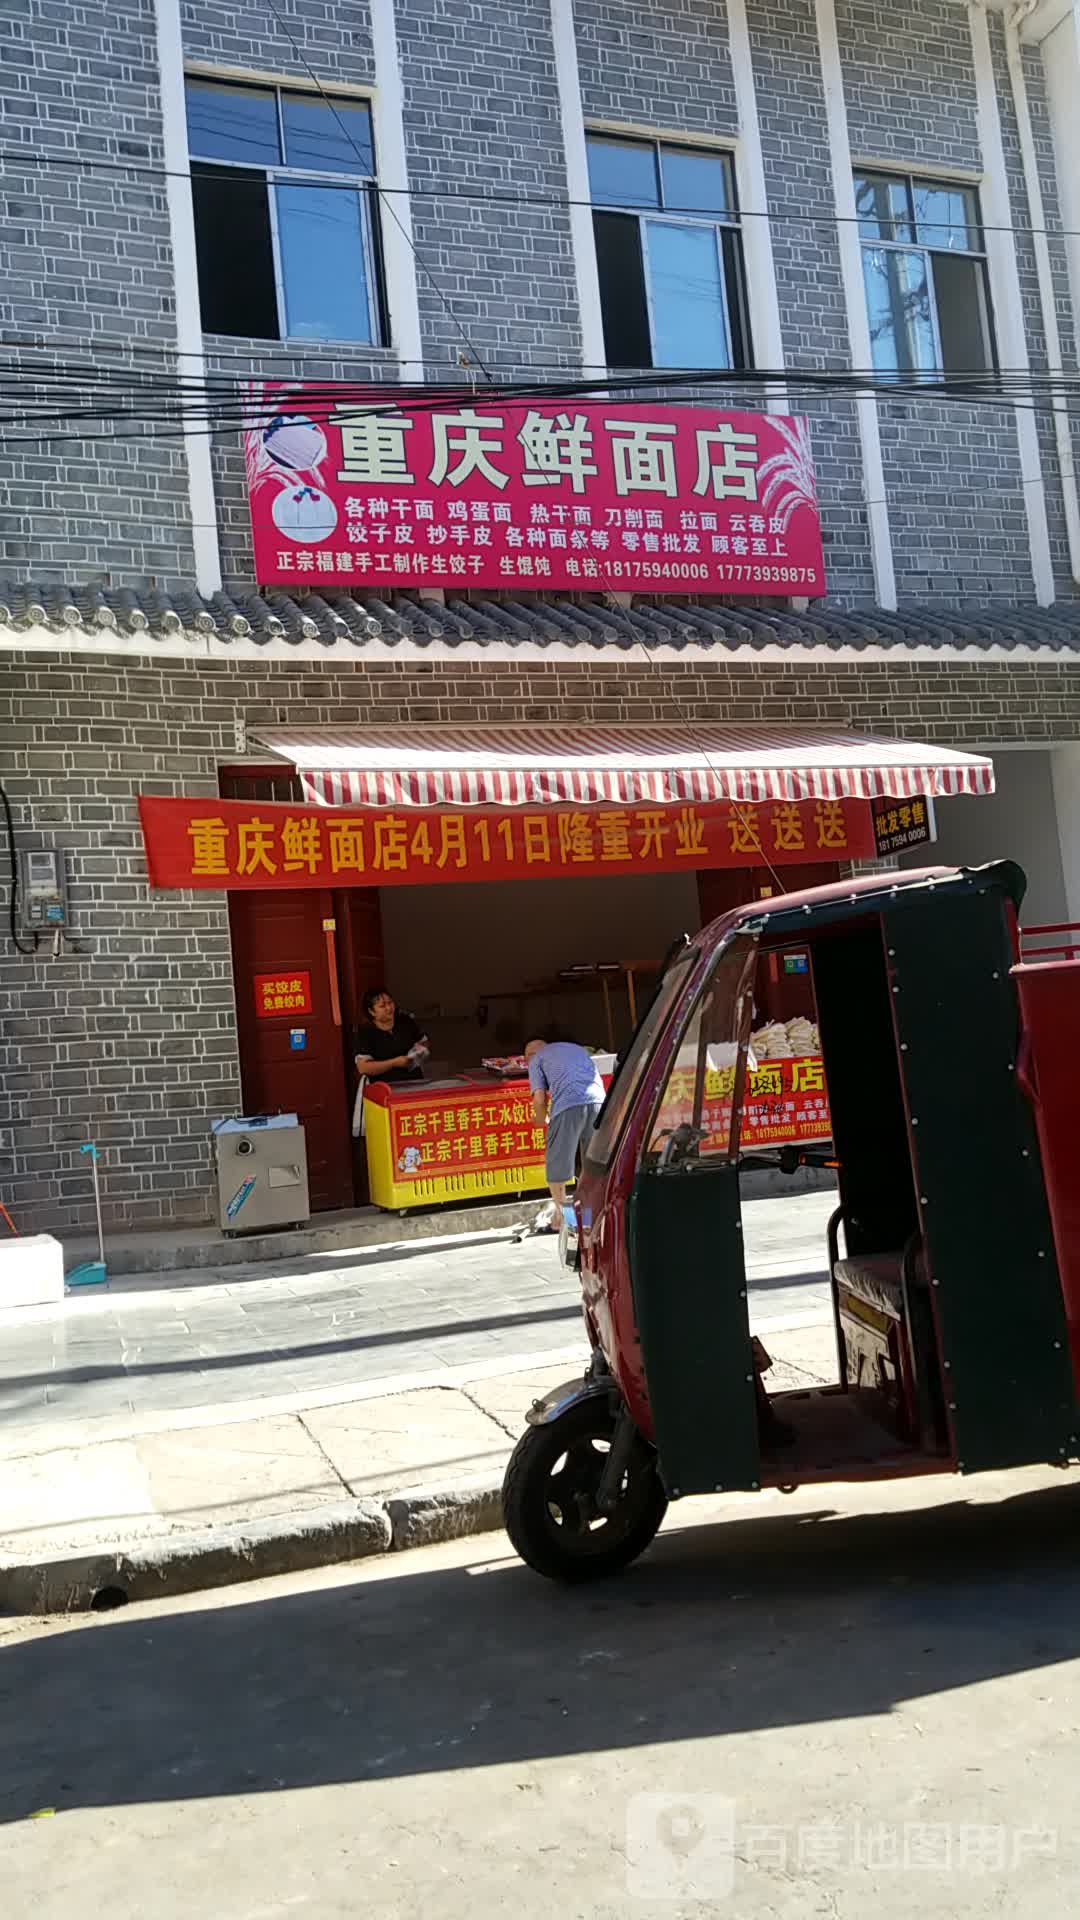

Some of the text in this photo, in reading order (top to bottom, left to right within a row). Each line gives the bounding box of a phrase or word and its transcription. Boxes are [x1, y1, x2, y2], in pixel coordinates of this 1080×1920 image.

[329, 403, 759, 501] 重庆鲜面店
[344, 496, 786, 535] 各种干面 鸡蛋面 热干面 刀削面 拉面 云吞皮
[346, 522, 788, 557] 饺子皮 抄手皮 各种面条等 零售批发 顾客至上
[276, 550, 485, 575] 正宗福建手工制作生饺子
[499, 555, 552, 576] 生馄饨
[717, 564, 817, 584] 17773939875
[875, 801, 925, 837] 批发零售
[187, 806, 709, 875] 重庆鲜面店4月11日隆重开业
